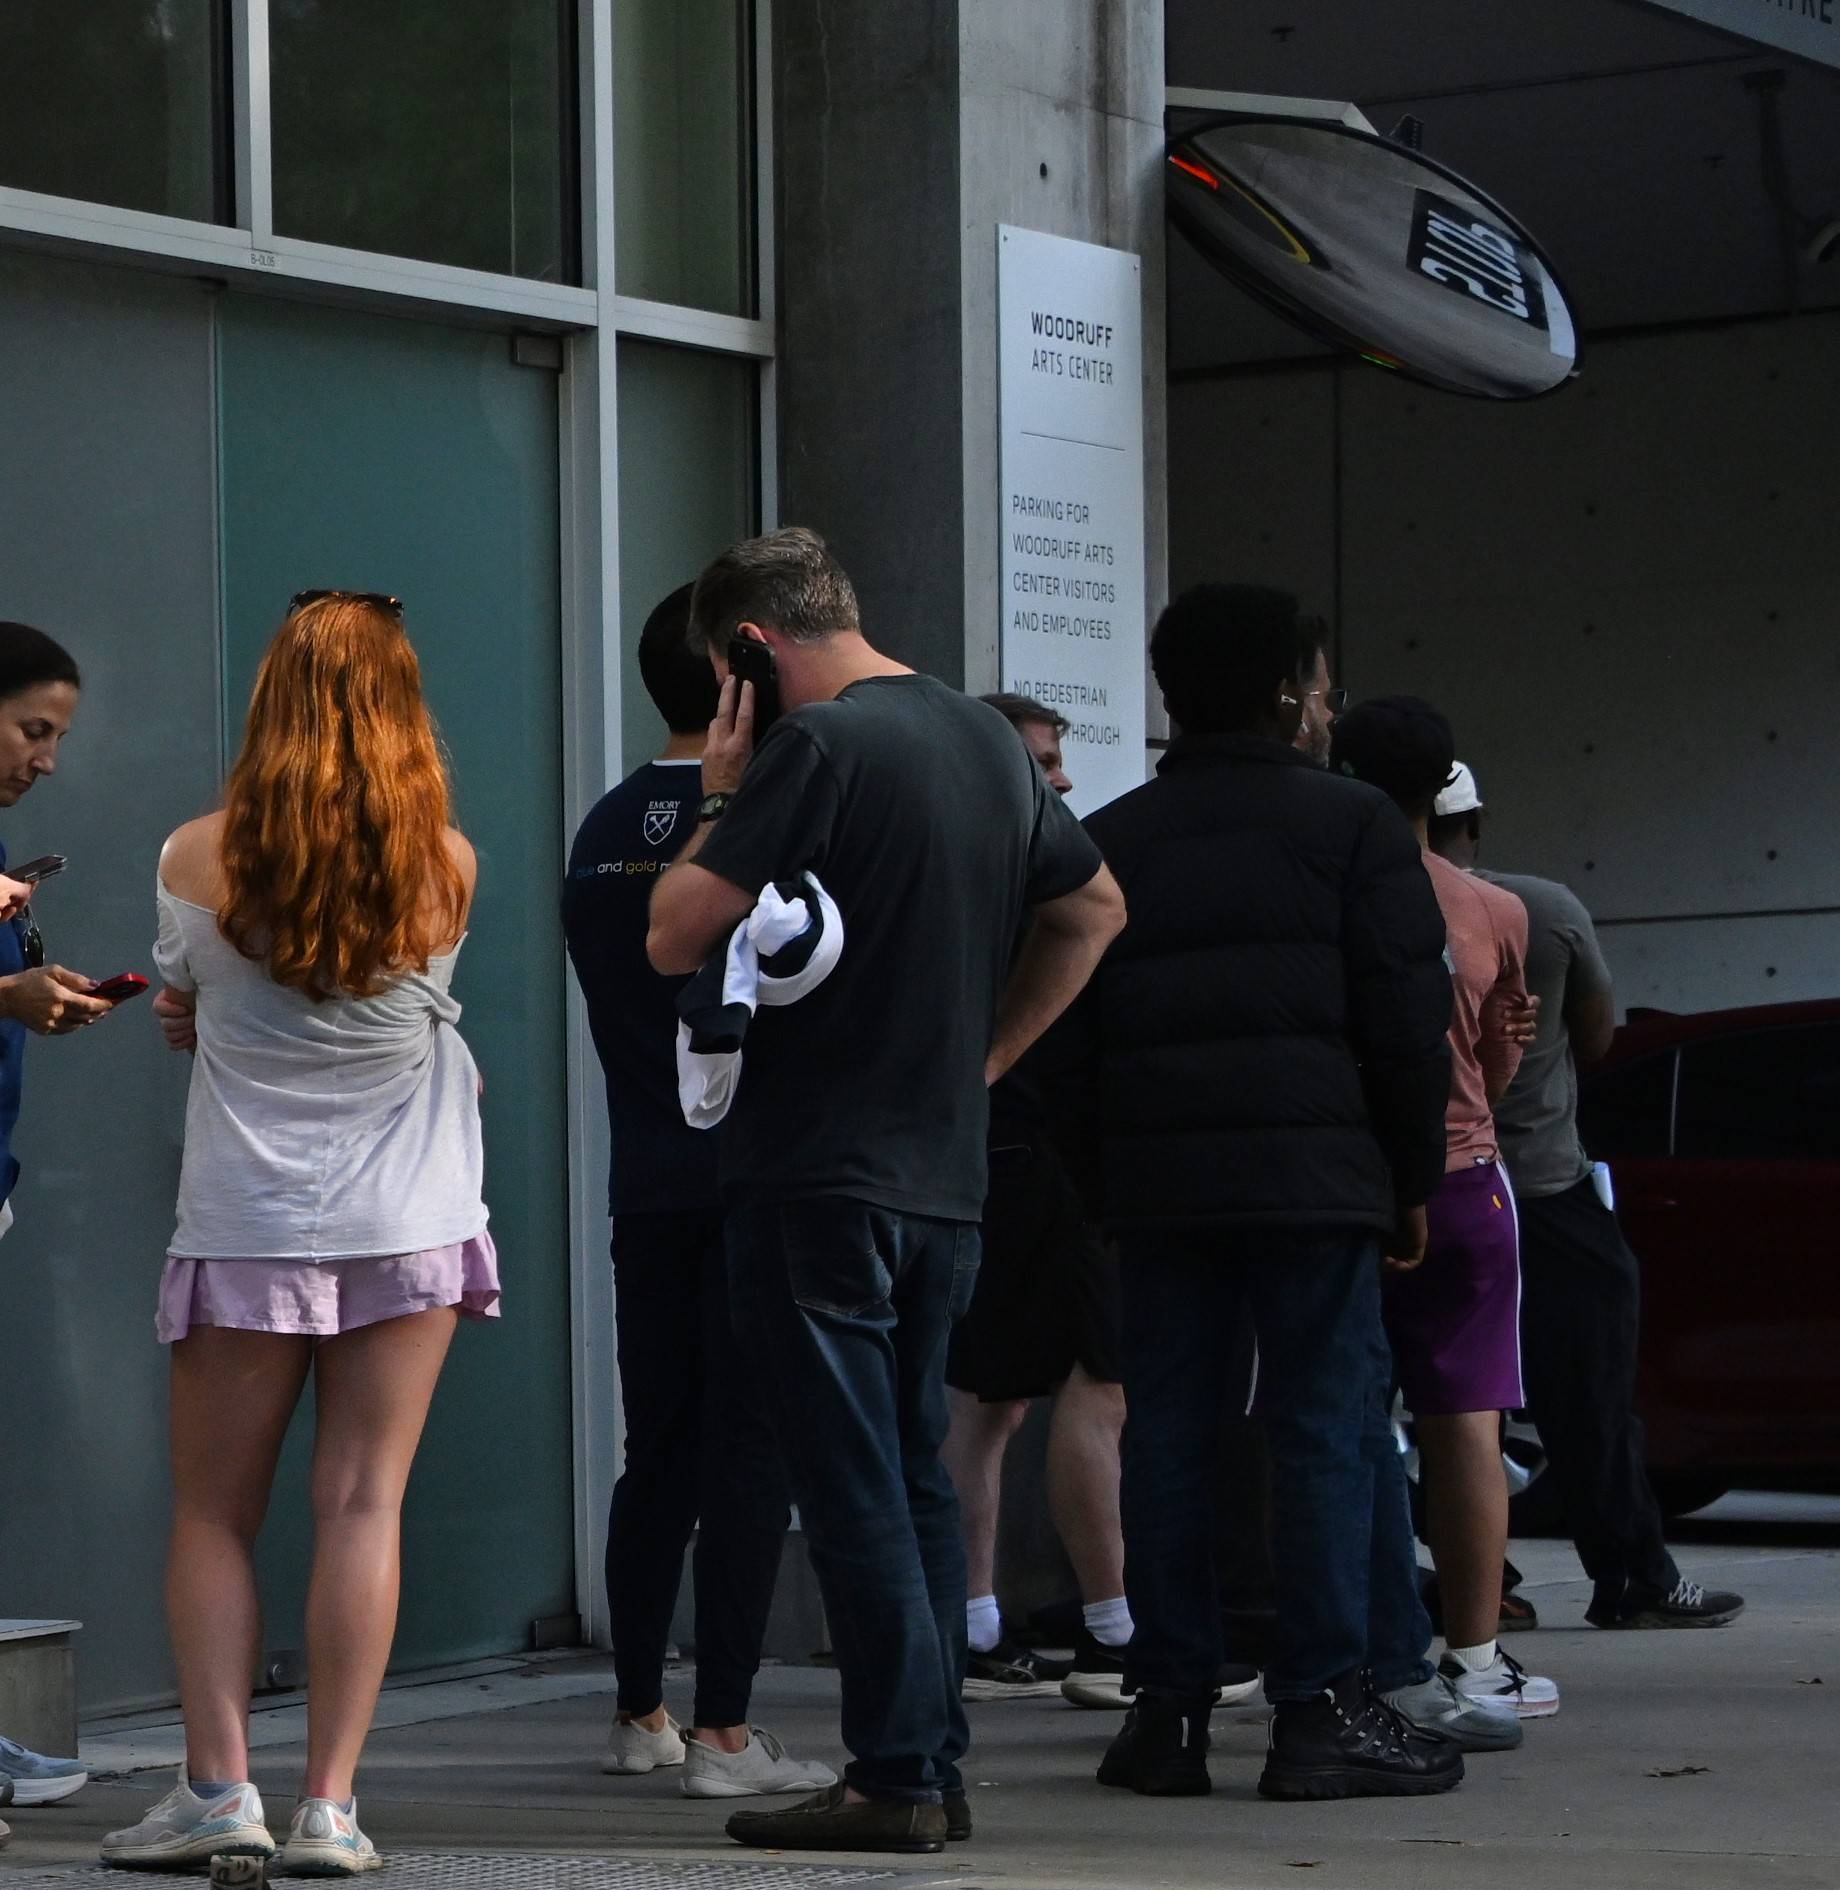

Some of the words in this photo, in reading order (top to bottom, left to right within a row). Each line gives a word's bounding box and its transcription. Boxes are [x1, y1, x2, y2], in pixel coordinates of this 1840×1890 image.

[1031, 311, 1113, 349] WOODRUFF
[1031, 348, 1063, 375] ARTS
[1068, 356, 1113, 385] CENTER
[1012, 495, 1063, 521] PARKING
[1066, 503, 1089, 525] FOR
[1013, 533, 1081, 561] WOODRUFF
[1084, 544, 1114, 566] ARTS
[1012, 572, 1060, 596] CENTER
[1063, 578, 1115, 603] VISITORS
[1013, 610, 1039, 632] AND
[1042, 614, 1112, 640] EMPLOYEES
[1034, 681, 1108, 707] PEDESTRIAN
[648, 801, 680, 810] EMORY
[597, 860, 623, 874] and
[625, 860, 656, 875] gold
